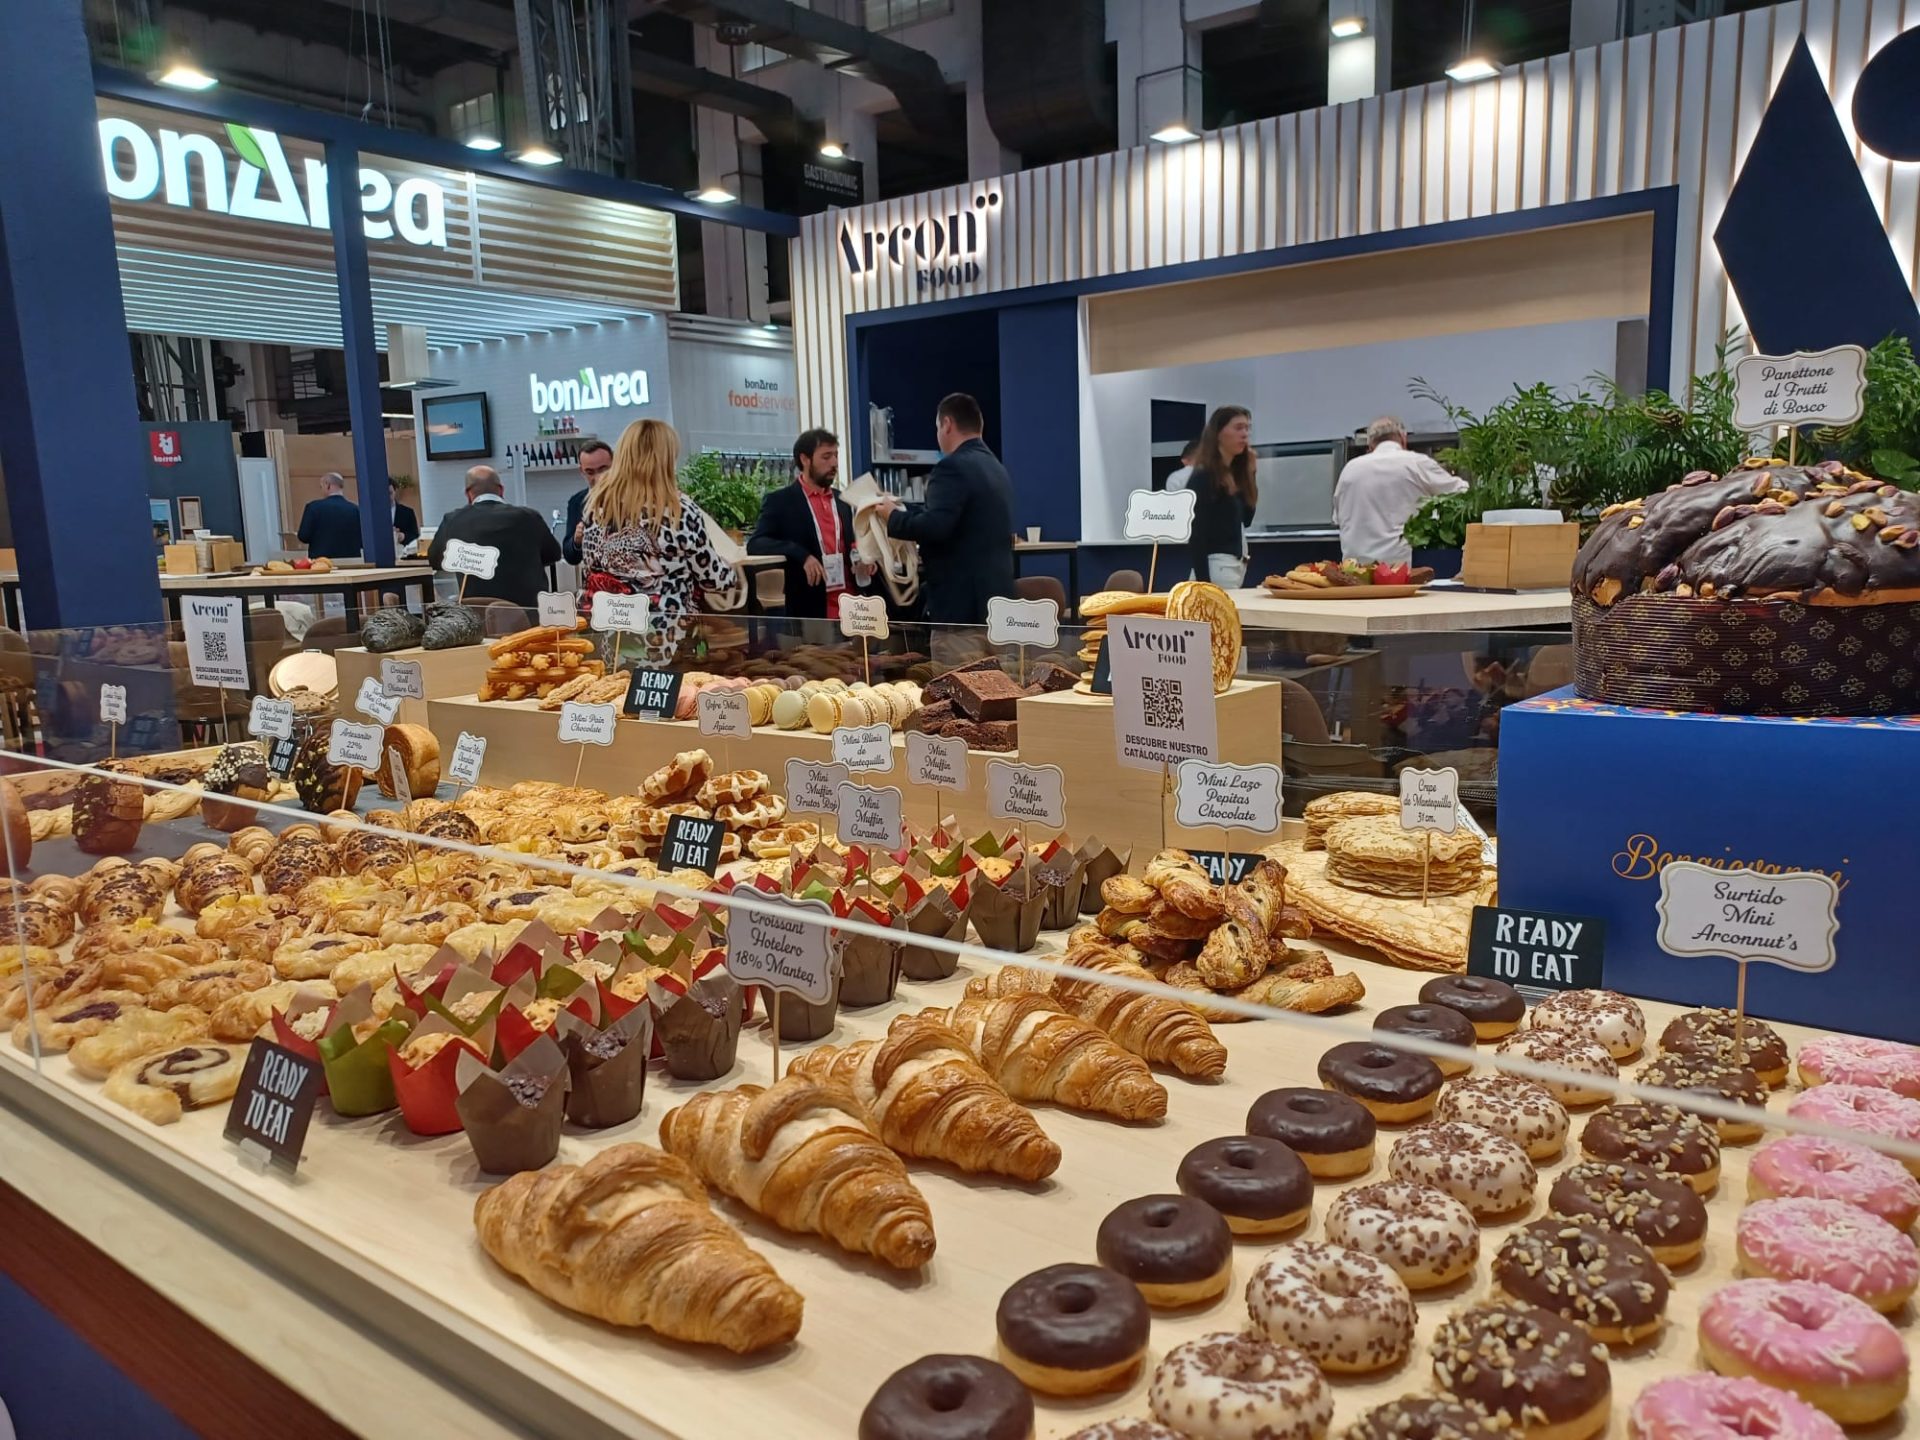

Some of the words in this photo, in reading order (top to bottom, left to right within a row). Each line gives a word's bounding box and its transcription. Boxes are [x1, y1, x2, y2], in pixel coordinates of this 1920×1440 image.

[917, 262, 979, 291] FOOD
[1761, 366, 1835, 381] Panettone
[530, 367, 649, 413] bonArea
[1764, 383, 1780, 398] al
[1784, 382, 1828, 397] Frutti
[1763, 401, 1779, 415] di
[1782, 399, 1827, 414] Bosco
[1142, 509, 1176, 521] Pancake
[607, 599, 635, 609] Palmera
[611, 608, 629, 617] Mini
[607, 617, 631, 626] Cocida
[1006, 616, 1040, 628] Brownie
[1158, 653, 1187, 665] FOOD
[640, 671, 674, 691] READY
[634, 689, 646, 706] TO
[648, 691, 669, 708] EAT
[723, 700, 740, 710] Mini
[570, 712, 586, 723] Mini
[588, 713, 605, 724] Pain
[719, 711, 727, 720] de
[571, 722, 602, 733] Chocolate
[346, 741, 362, 750] 22%
[842, 735, 860, 745] Mini
[861, 733, 883, 744] Blinis
[1125, 734, 1168, 750] DESCUBRE
[1169, 741, 1208, 756] NUESTRO
[857, 745, 866, 755] de
[928, 743, 947, 757] Mini
[925, 756, 951, 772] Muffin
[809, 769, 829, 782] Mini
[920, 768, 957, 784] Manzana
[1013, 772, 1037, 787] Mini
[1196, 772, 1228, 788] Mini
[1229, 775, 1263, 792] Lazo
[805, 783, 833, 798] Muffin
[1009, 786, 1042, 804] Muffin
[1206, 788, 1249, 805] Pepitas
[795, 794, 820, 809] Frutos
[859, 795, 880, 809] Mini
[1404, 793, 1411, 806] de
[1004, 800, 1049, 817] Chocolate
[1198, 803, 1257, 821] Chocolate
[855, 810, 884, 827] Muffin
[677, 819, 714, 843] READY
[851, 824, 889, 841] Caramelo
[671, 842, 685, 863] TO
[686, 845, 710, 867] EAT
[1714, 881, 1787, 906] Surtido
[749, 910, 805, 935] Croissant
[1722, 903, 1775, 926] Mini
[1496, 914, 1583, 951] READY
[1692, 923, 1798, 951] Arconnut's
[751, 927, 804, 957] Hotelero
[735, 950, 763, 970] 18%
[765, 953, 817, 987] Manteq.
[1491, 946, 1520, 978] TO
[1531, 951, 1579, 984] EAT
[258, 1049, 309, 1101] READY
[243, 1089, 266, 1130] TO
[261, 1099, 294, 1145] EAT
